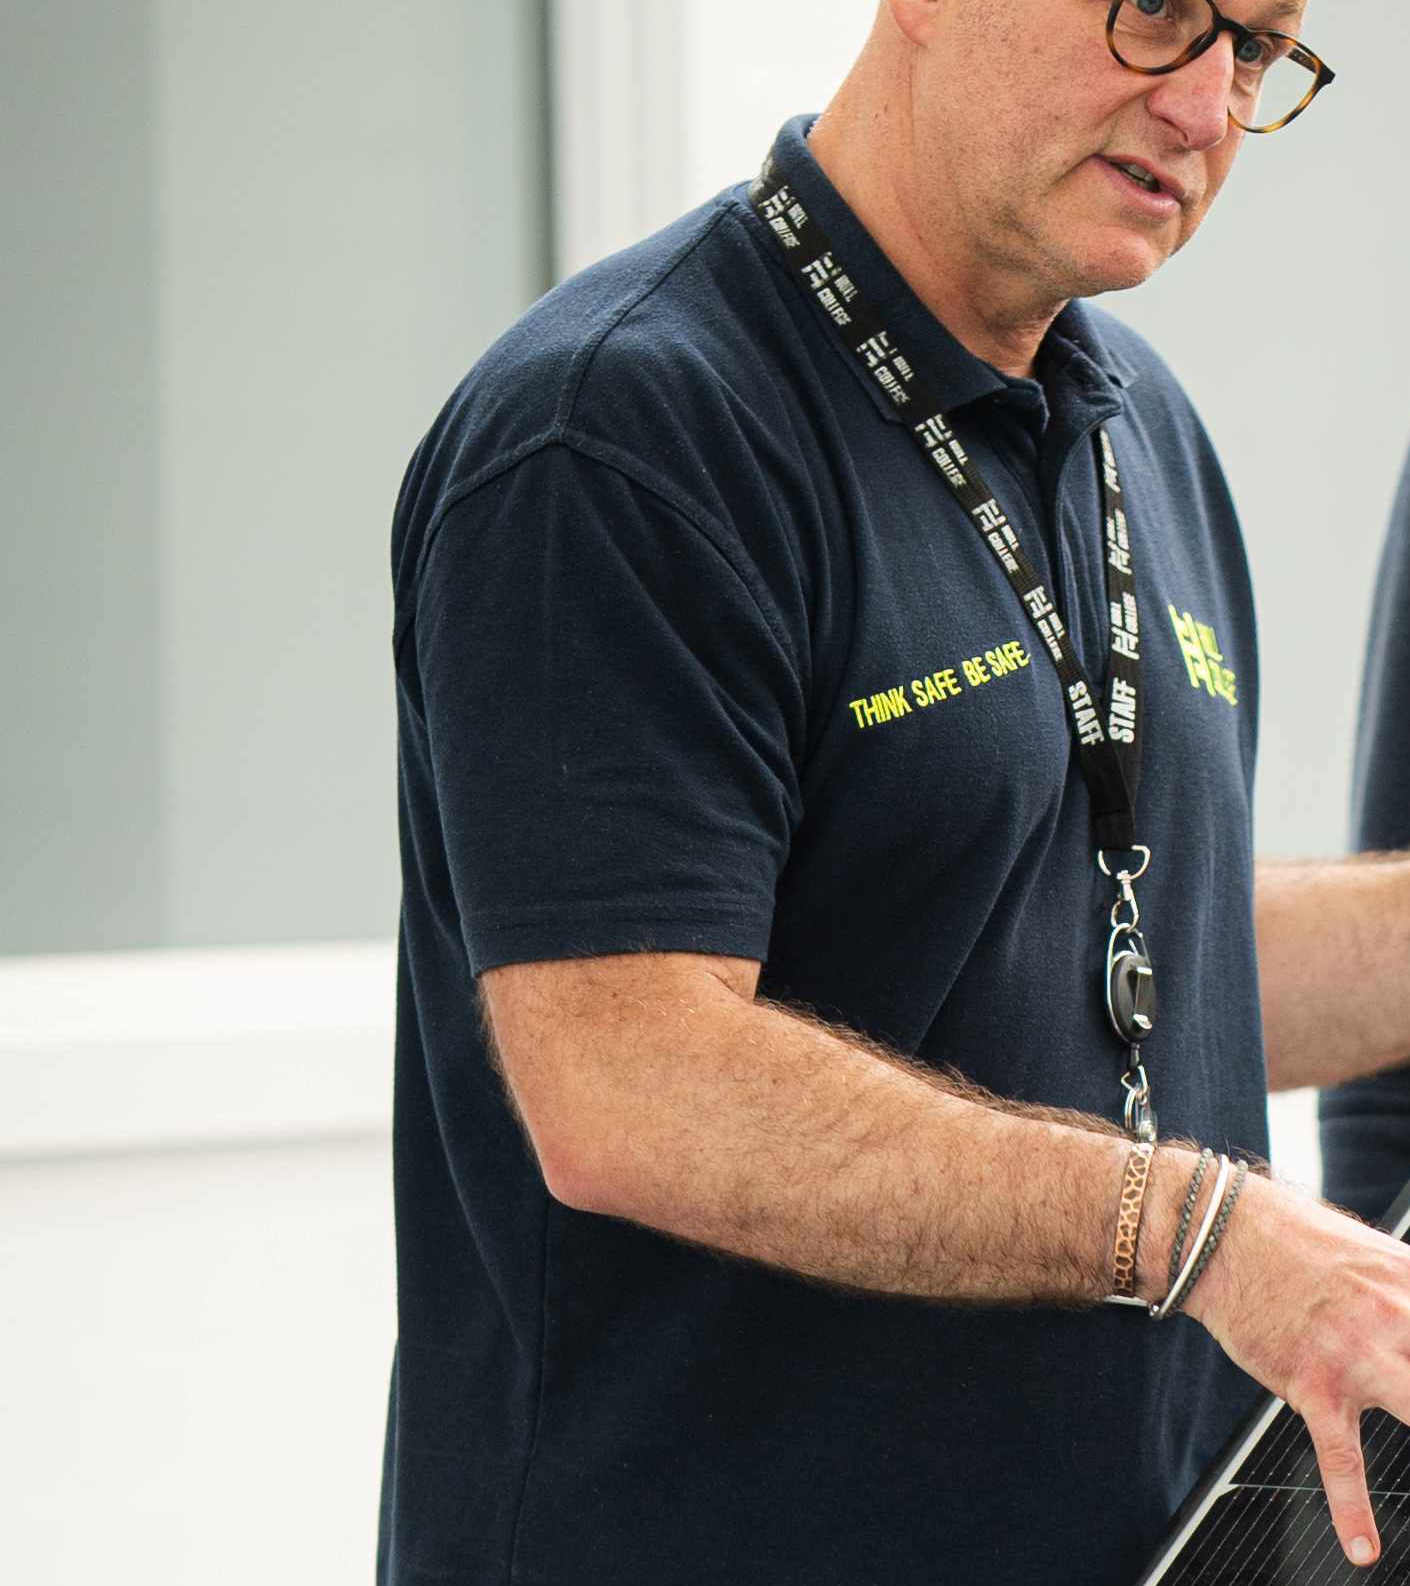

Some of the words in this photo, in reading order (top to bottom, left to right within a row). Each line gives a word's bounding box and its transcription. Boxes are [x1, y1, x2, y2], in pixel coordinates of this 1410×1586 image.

[931, 447, 967, 489] COLLEGE
[849, 685, 913, 729] THINK
[911, 668, 963, 708] SAFE
[961, 656, 992, 687] BE
[984, 640, 1031, 678] SAFE
[1068, 680, 1105, 746] STAFF
[1108, 676, 1136, 744] STAFF
